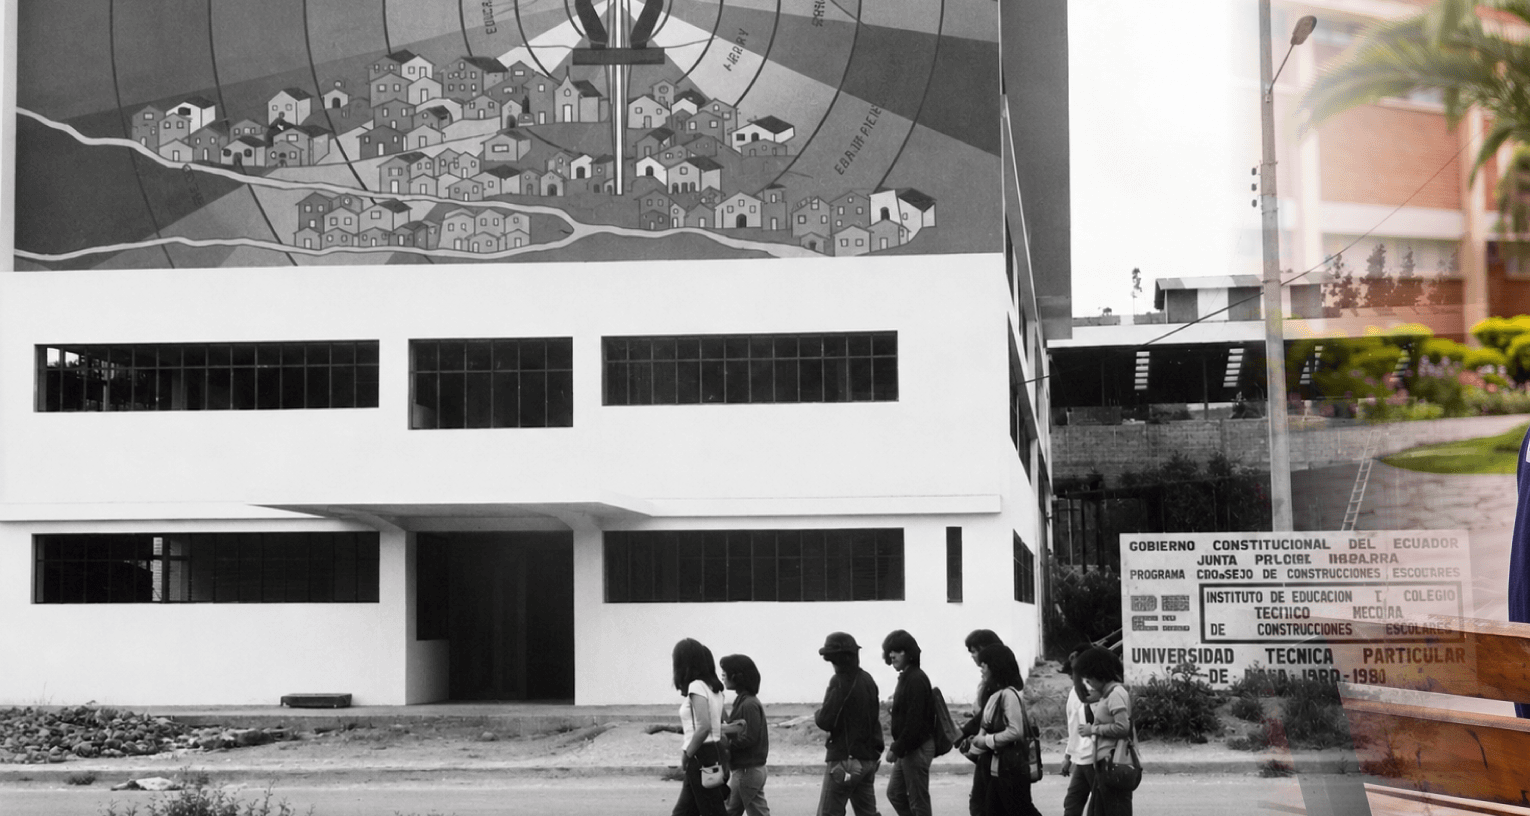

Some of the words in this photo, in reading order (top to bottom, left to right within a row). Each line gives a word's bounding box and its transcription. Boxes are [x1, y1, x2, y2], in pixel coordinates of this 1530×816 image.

[1129, 541, 1196, 552] GOBIERNO
[1213, 539, 1331, 551] CONSTITUCIONAL
[1348, 538, 1376, 550] DEL
[1393, 537, 1459, 549] ECUADOR
[1197, 554, 1238, 566] JUNTA
[1130, 569, 1186, 580] PROGRAMA
[1263, 569, 1278, 580] DE
[1287, 567, 1381, 579] CONSTRUCCIONES
[1206, 591, 1263, 604] INSTITUTO
[1270, 591, 1285, 603] DE
[1292, 590, 1353, 603] EDUCACION
[1403, 589, 1456, 602] COLEGIO
[1210, 623, 1226, 636] DE
[1257, 623, 1353, 636] CONSTRUCCIONES
[1385, 622, 1454, 635] ESCOLARES
[1131, 648, 1235, 665] UNIVERSIDAD
[1265, 648, 1334, 665] TECNICA
[1362, 647, 1467, 664] PARTICULAR
[1209, 669, 1229, 684] DE
